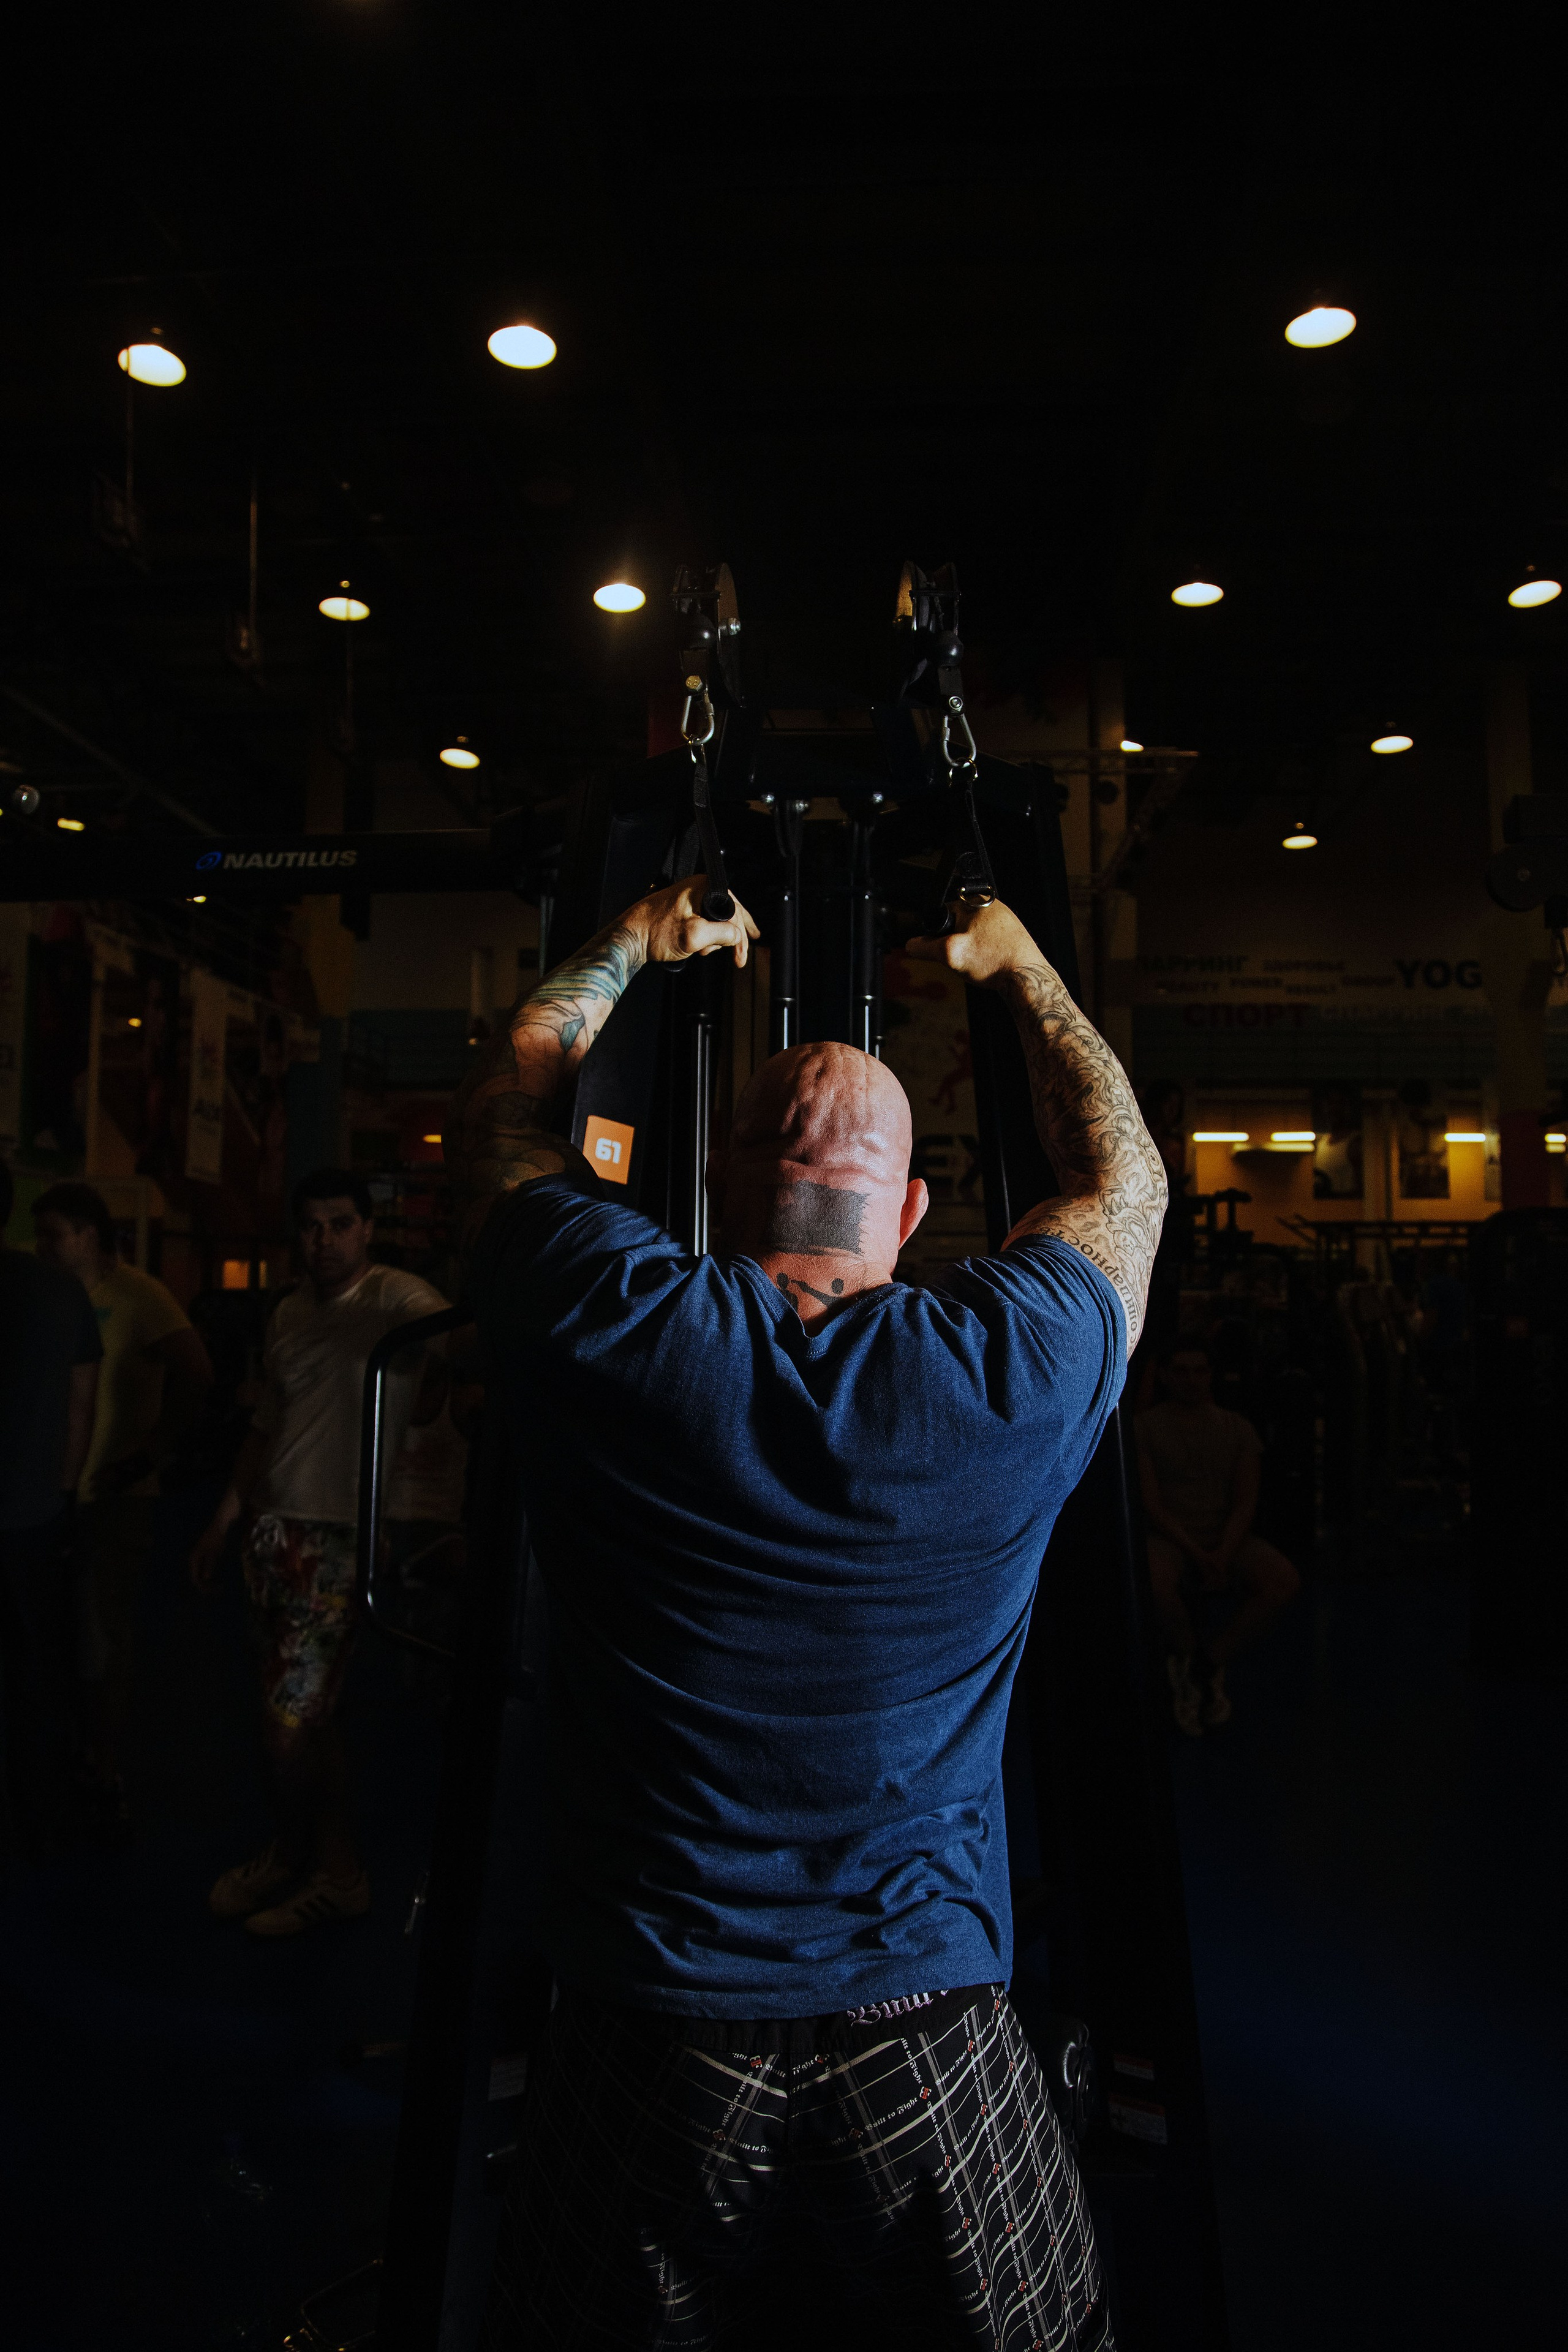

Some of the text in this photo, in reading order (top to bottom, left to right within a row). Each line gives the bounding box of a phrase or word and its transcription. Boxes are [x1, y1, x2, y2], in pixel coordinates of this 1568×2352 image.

[222, 850, 358, 870] NAUTILUS
[1183, 1003, 1311, 1028] СПОРТ
[595, 1137, 622, 1164] 61
[738, 2071, 753, 2093] Bilt
[864, 2117, 886, 2131] Built
[896, 2097, 918, 2115] Fight
